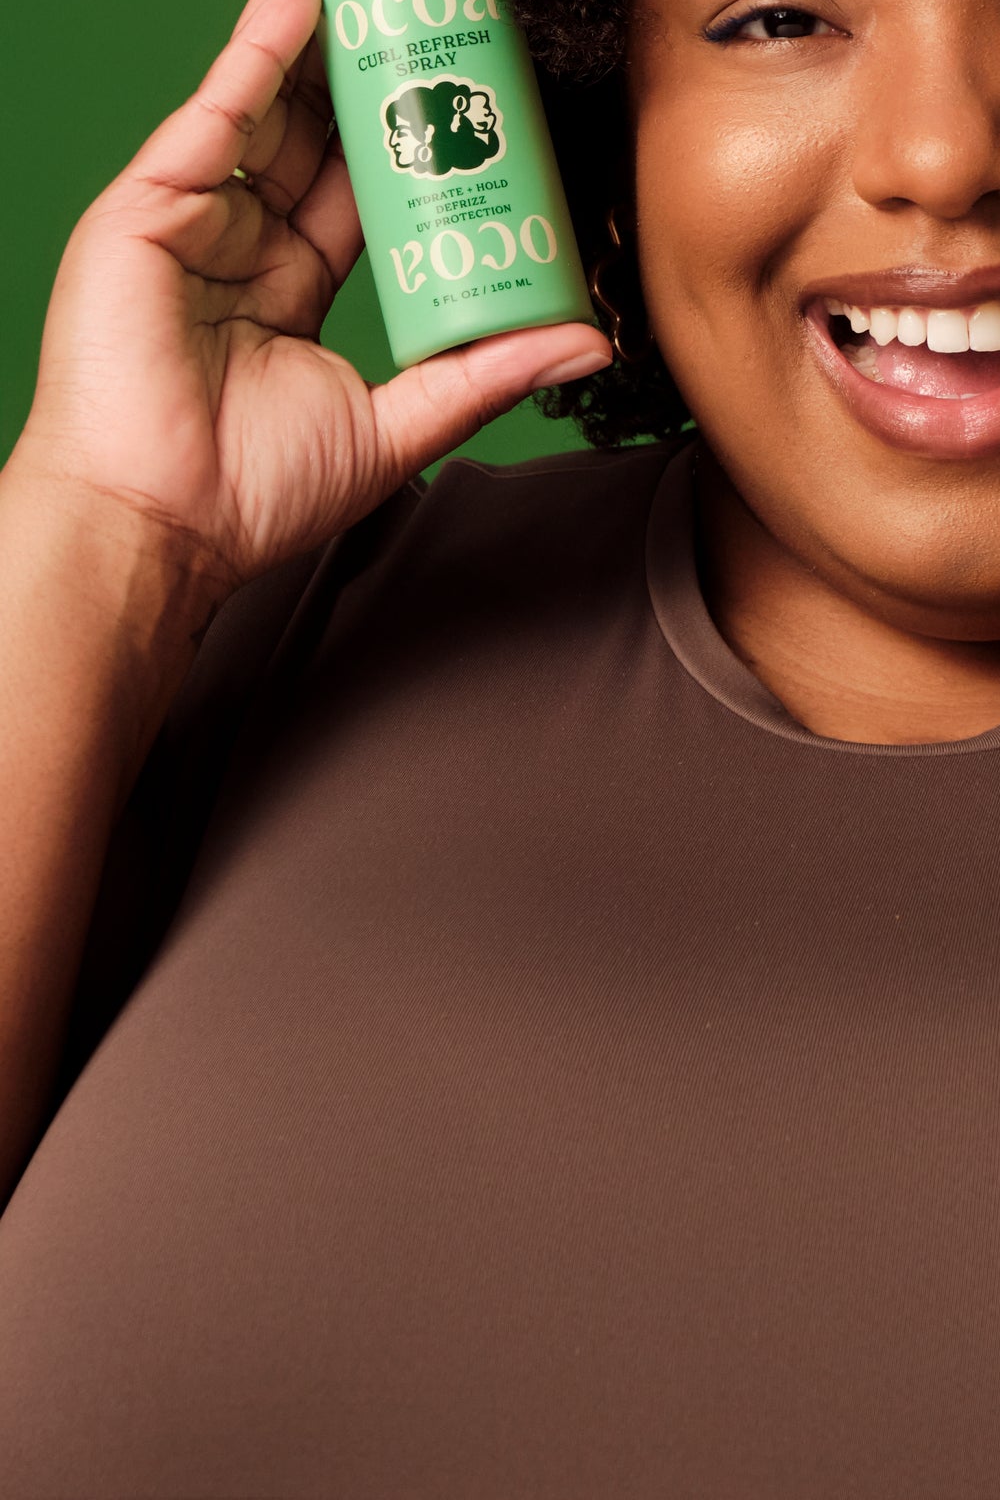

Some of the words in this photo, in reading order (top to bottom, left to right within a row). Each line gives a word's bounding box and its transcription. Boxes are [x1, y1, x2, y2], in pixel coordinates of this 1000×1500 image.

[358, 47, 401, 72] CURL
[406, 30, 491, 57] REFRESH
[396, 51, 457, 77] SPRAY
[408, 187, 464, 209] HYDRATE
[476, 179, 508, 192] HOLD
[435, 195, 487, 214] DEFRIZZ
[416, 221, 432, 233] UV
[435, 203, 512, 227] PROTECTION
[389, 214, 558, 294] ocoa
[433, 298, 440, 307] 5
[443, 294, 457, 304] FL
[461, 288, 480, 299] OZ
[491, 281, 512, 293] 150
[515, 277, 533, 288] ML
